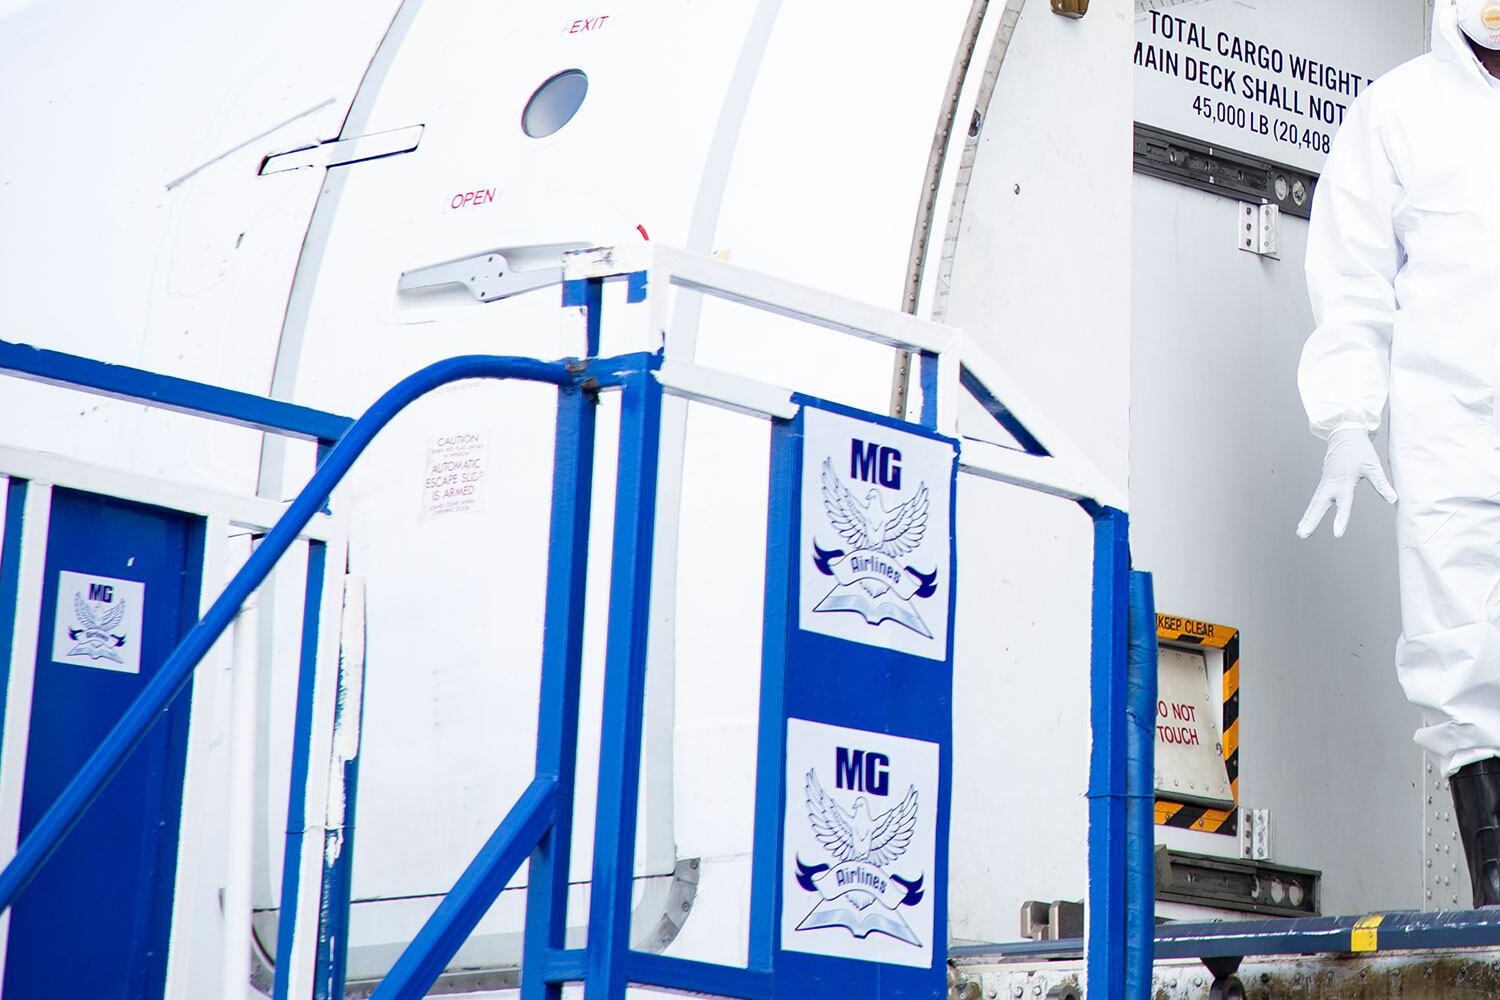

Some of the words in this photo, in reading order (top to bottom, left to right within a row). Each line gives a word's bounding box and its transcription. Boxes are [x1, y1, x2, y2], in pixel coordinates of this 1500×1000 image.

[569, 15, 610, 34] EXIT
[1149, 10, 1211, 52] TOTAL
[1217, 32, 1283, 73] CARGO
[1289, 54, 1362, 97] WEIGHT
[1185, 56, 1236, 94] DECK
[1242, 75, 1303, 115] SHALL
[1309, 95, 1347, 126] NOT
[1192, 95, 1245, 128] 45,000
[1250, 112, 1269, 135] LB
[1273, 119, 1330, 154] (20,408
[451, 188, 496, 210] OPEN
[850, 438, 903, 491] MG
[850, 555, 901, 584] Airlines
[88, 583, 113, 603] MG
[1158, 615, 1182, 631] KEEP
[1184, 620, 1214, 637] CLEAR
[1155, 700, 1168, 718] O
[1171, 702, 1196, 722] NOT
[1156, 725, 1199, 745] TOUCH
[836, 746, 889, 797] MG
[836, 868, 888, 894] Airlines
